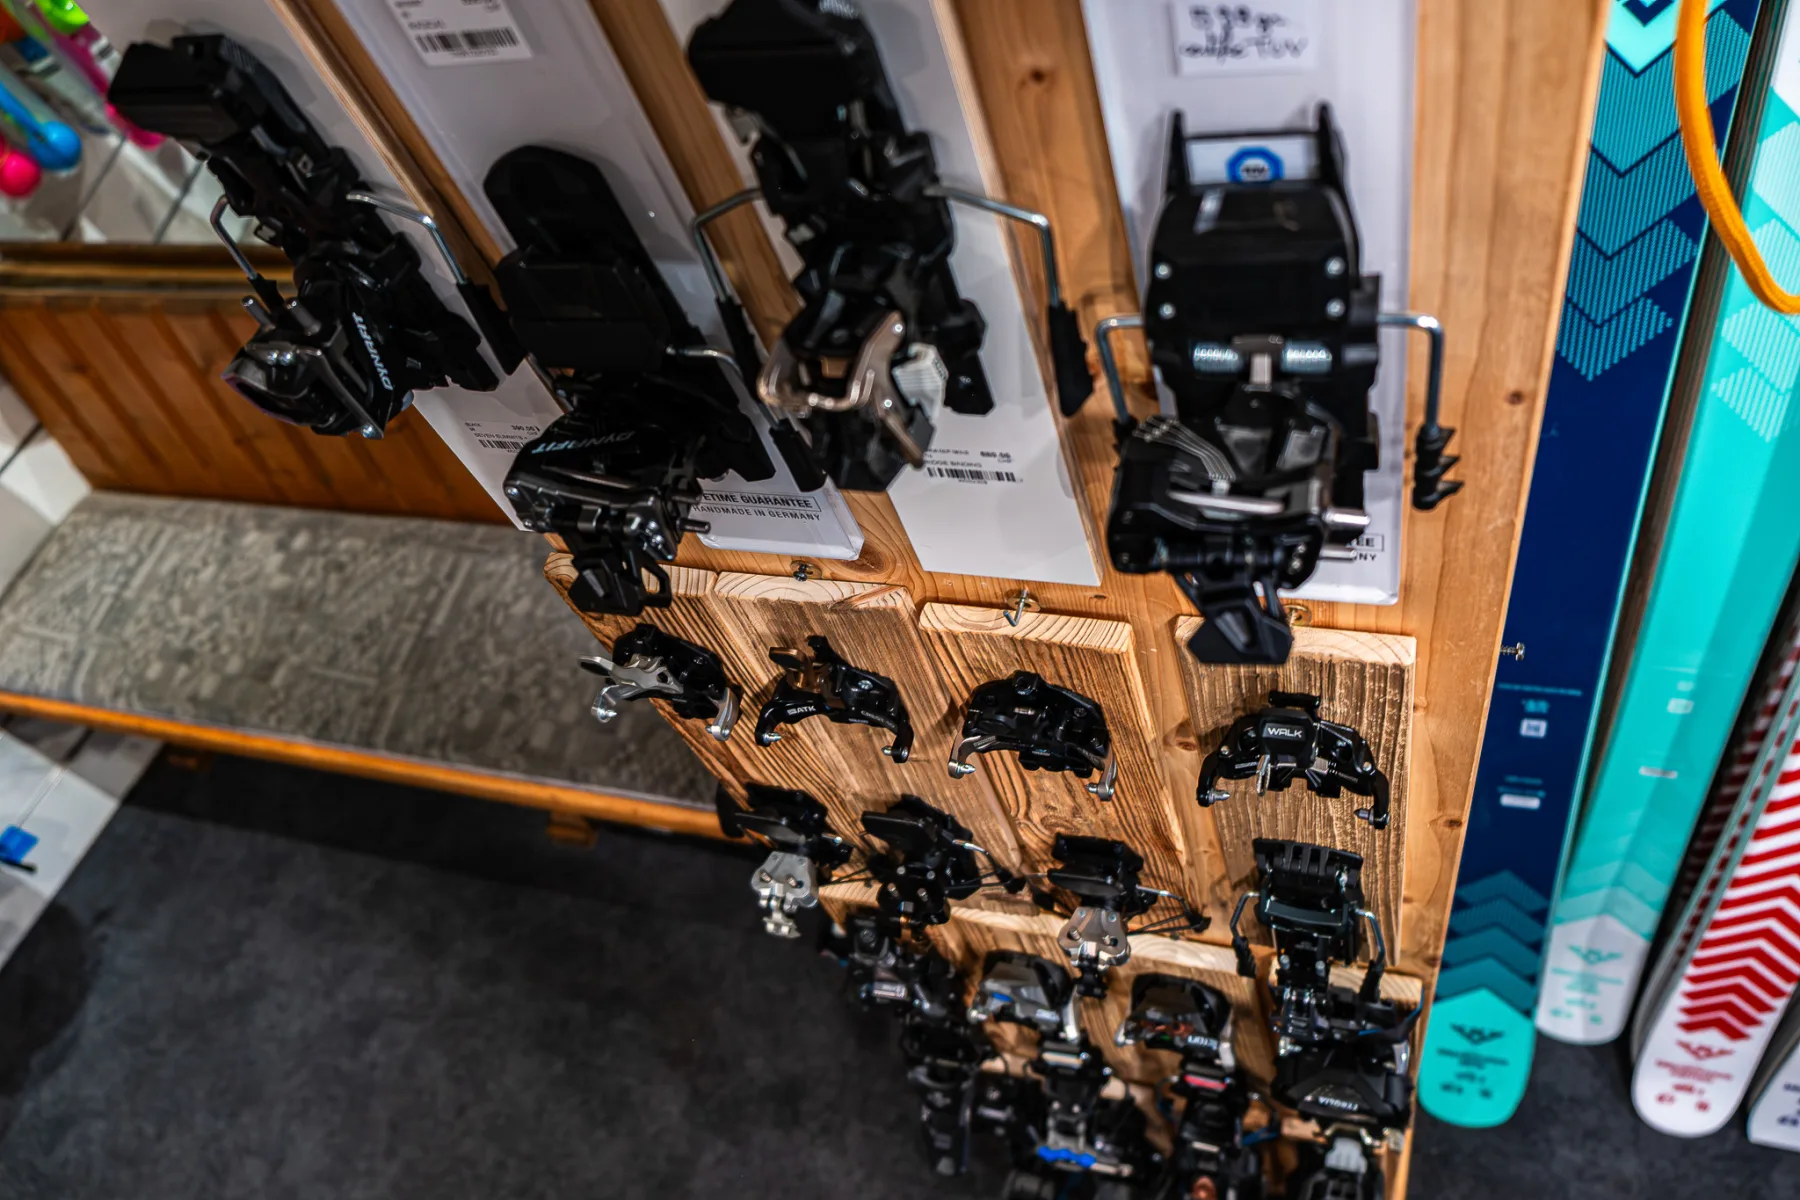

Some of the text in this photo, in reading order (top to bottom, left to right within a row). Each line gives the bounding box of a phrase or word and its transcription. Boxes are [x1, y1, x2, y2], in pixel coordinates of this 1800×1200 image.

[352, 312, 393, 390] DYNAFIT
[702, 493, 813, 508] ETIME GUARANTEE
[692, 505, 753, 516] HANDMADE
[768, 511, 821, 521] GERMANY
[1267, 726, 1303, 738] WALK
